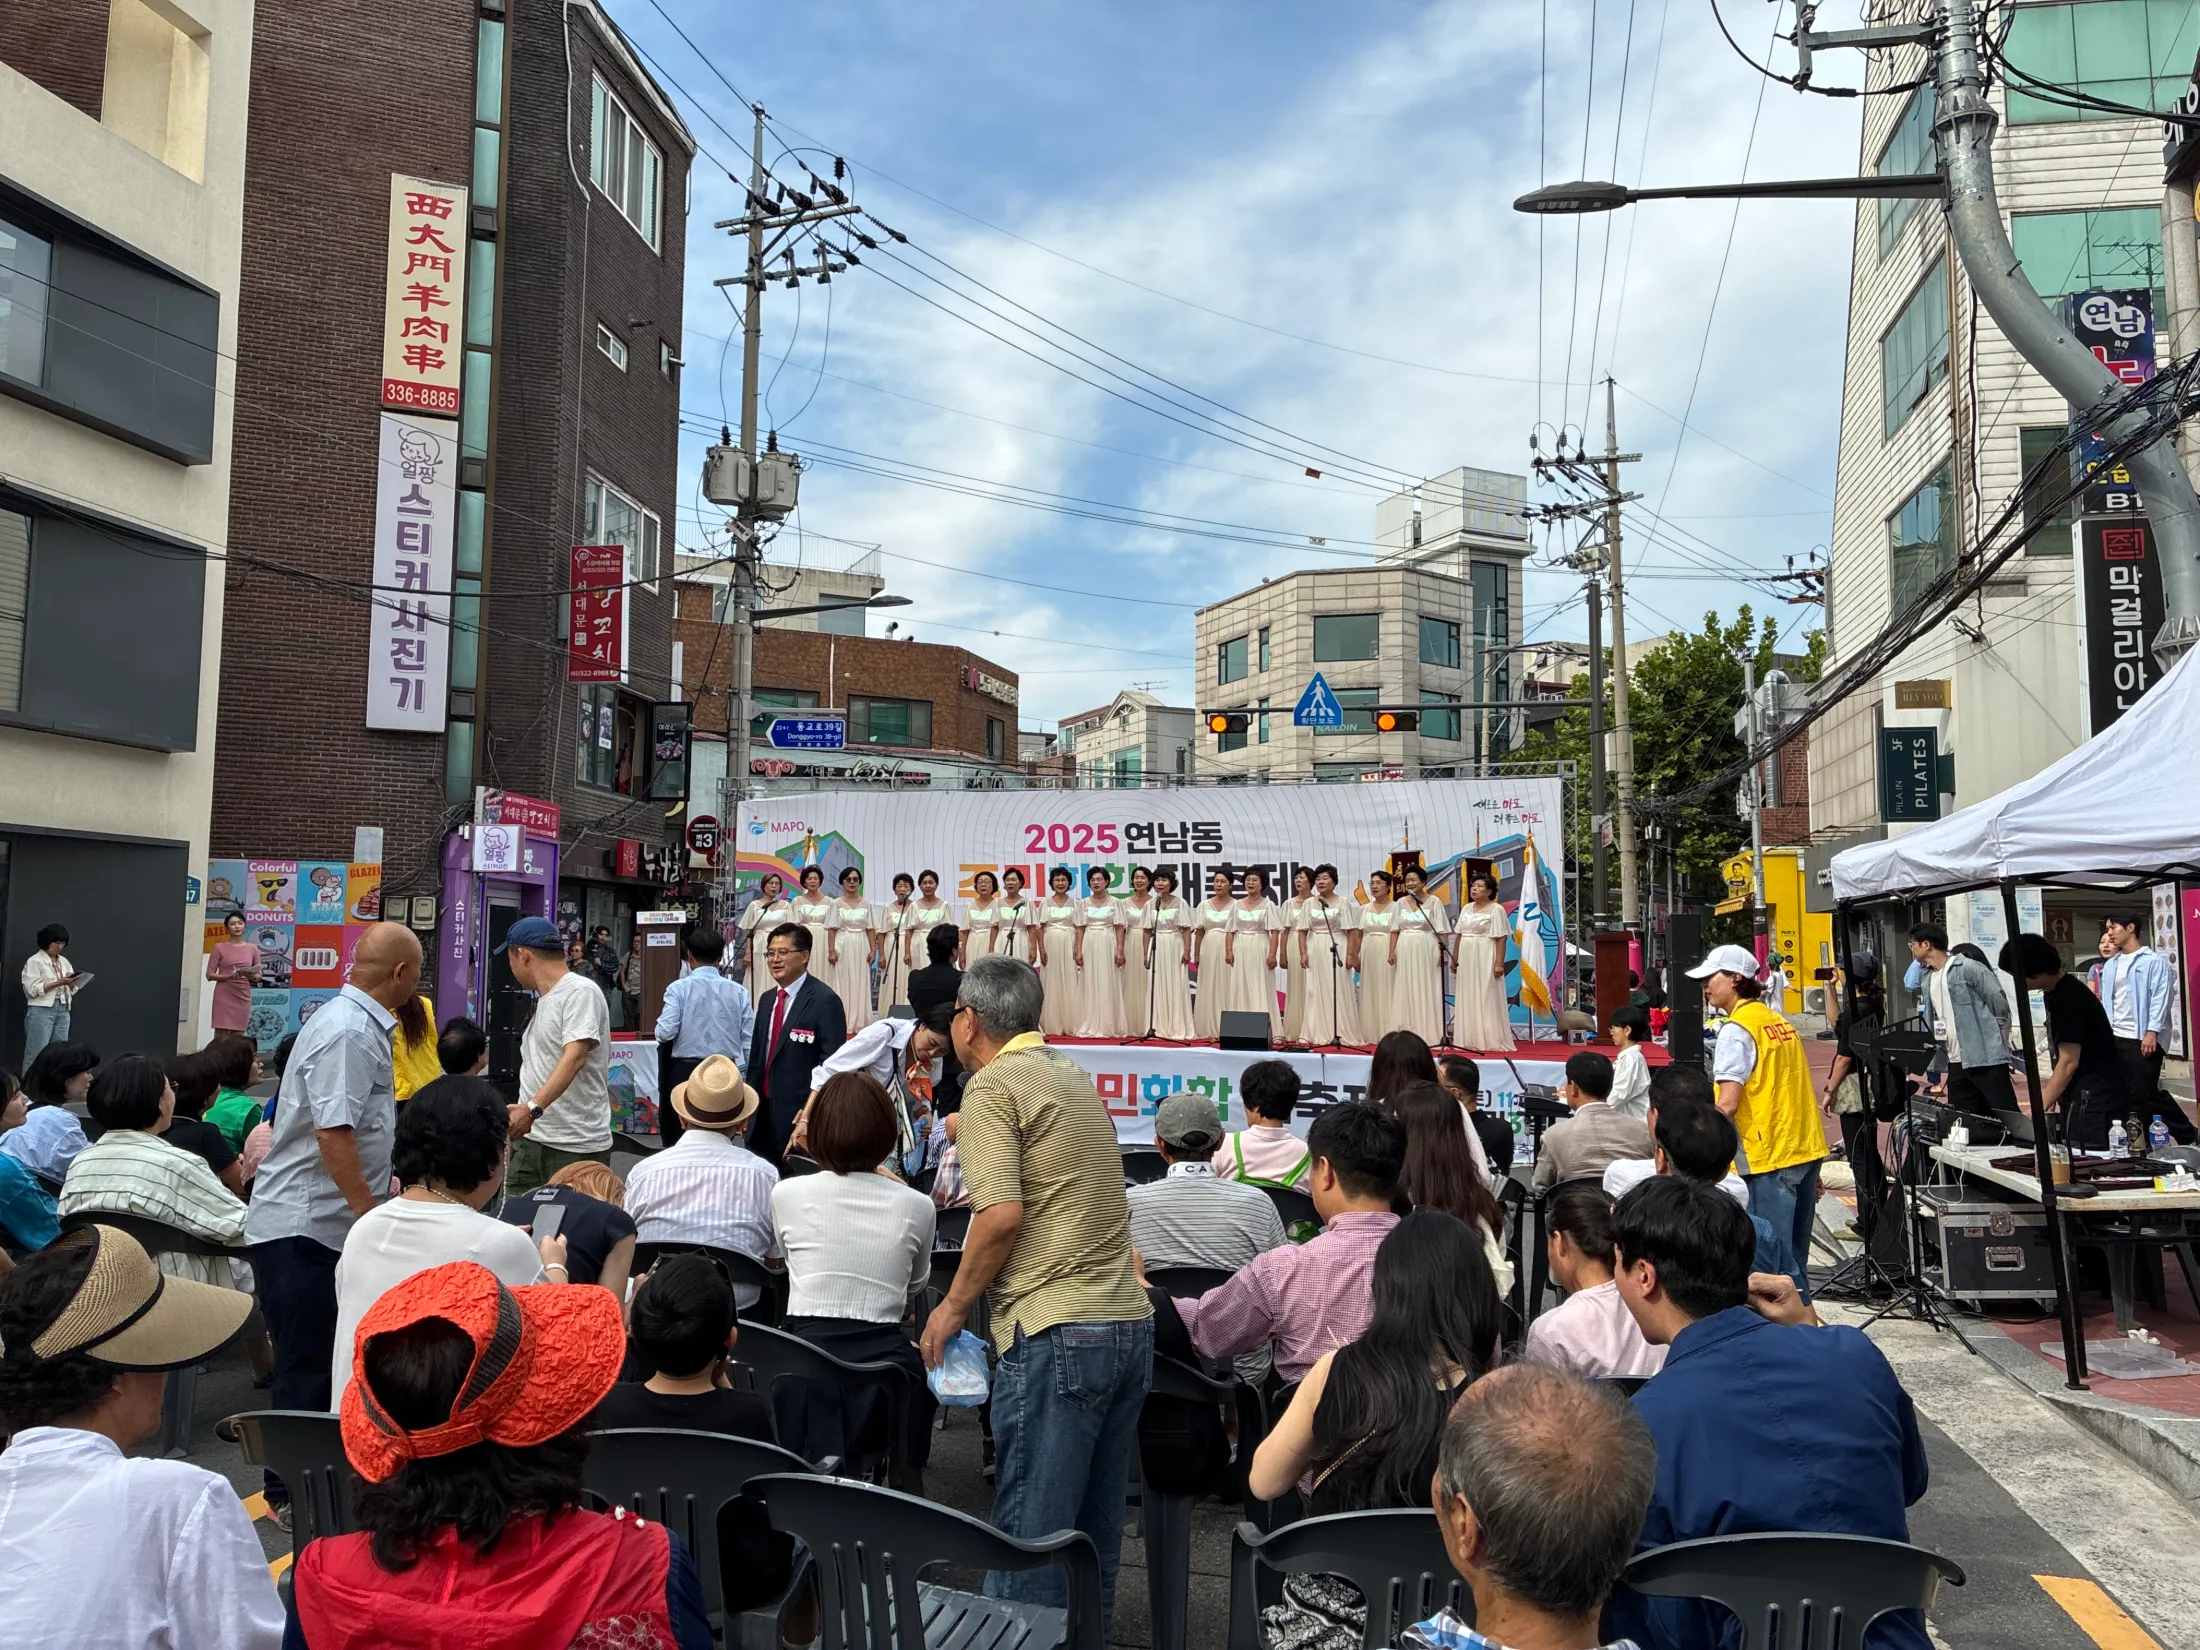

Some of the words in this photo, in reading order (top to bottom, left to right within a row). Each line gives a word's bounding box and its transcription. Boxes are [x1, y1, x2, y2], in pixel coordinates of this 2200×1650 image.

[400, 191, 456, 376] 西大門羊肉串
[2085, 302, 2141, 333] 연남
[387, 384, 455, 409] 336-8885
[401, 460, 437, 485] 얼짱
[390, 483, 435, 713] 스티커사진기
[1301, 717, 1335, 725] 횡단보도
[824, 733, 842, 741] 39-gil
[1892, 738, 1903, 751] 3F
[803, 765, 836, 778] 서대문
[1913, 738, 1928, 808] PILATES
[1473, 799, 1501, 810] 새로운
[1502, 798, 1524, 810] 마포
[1494, 814, 1503, 825] 더
[1504, 813, 1521, 824] 좋은
[1521, 812, 1543, 824] 마포
[771, 821, 805, 832] MAPO
[1024, 824, 1119, 854] 2025
[1124, 822, 1223, 854] 연남동
[484, 849, 506, 863] 얼짱
[249, 863, 297, 873] Colorful
[350, 866, 381, 878] GLAZE
[247, 913, 295, 922] DONUTS
[454, 900, 465, 959] 스티커사진
[1763, 1022, 1799, 1044] 마포구
